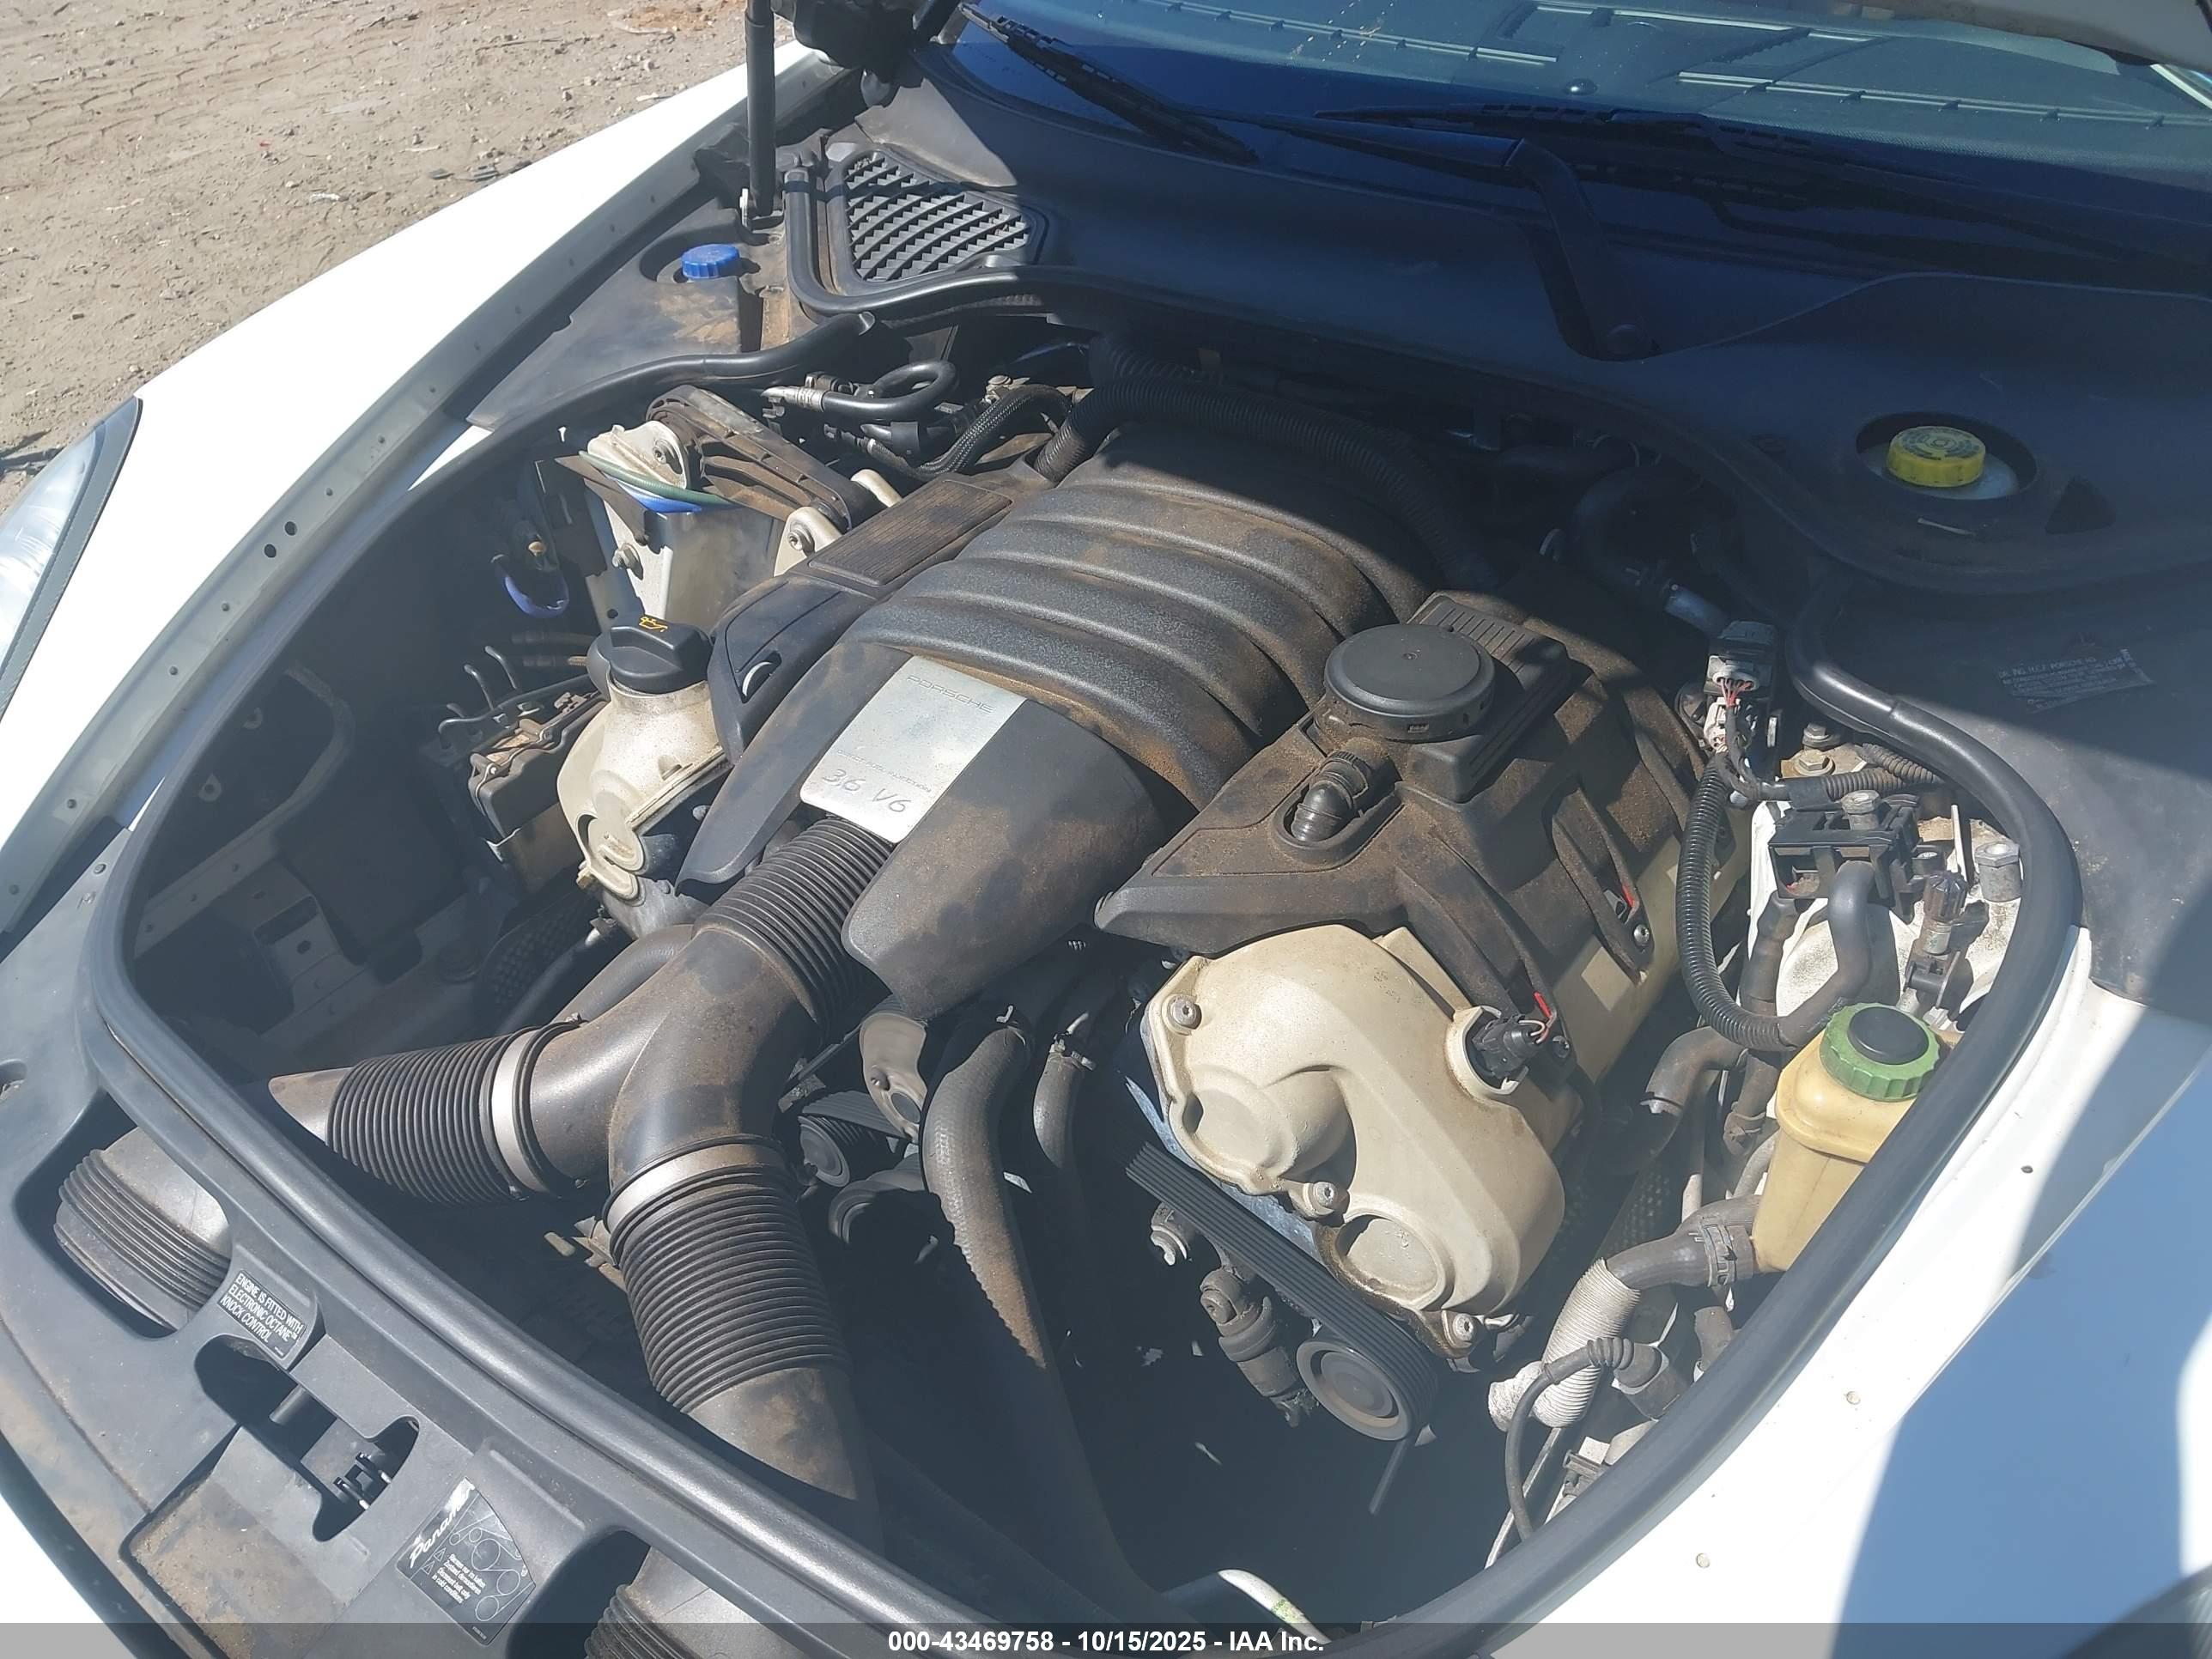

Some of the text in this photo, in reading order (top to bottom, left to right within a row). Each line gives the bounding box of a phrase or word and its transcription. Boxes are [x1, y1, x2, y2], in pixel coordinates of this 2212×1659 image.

[906, 675, 996, 714] PORSCHE
[872, 788, 911, 811] V6
[220, 1294, 272, 1343] KNOCK CONTROL
[228, 1284, 267, 1321] ELECTRONIC
[235, 1273, 304, 1334] ENGINE IS FITTED WITH
